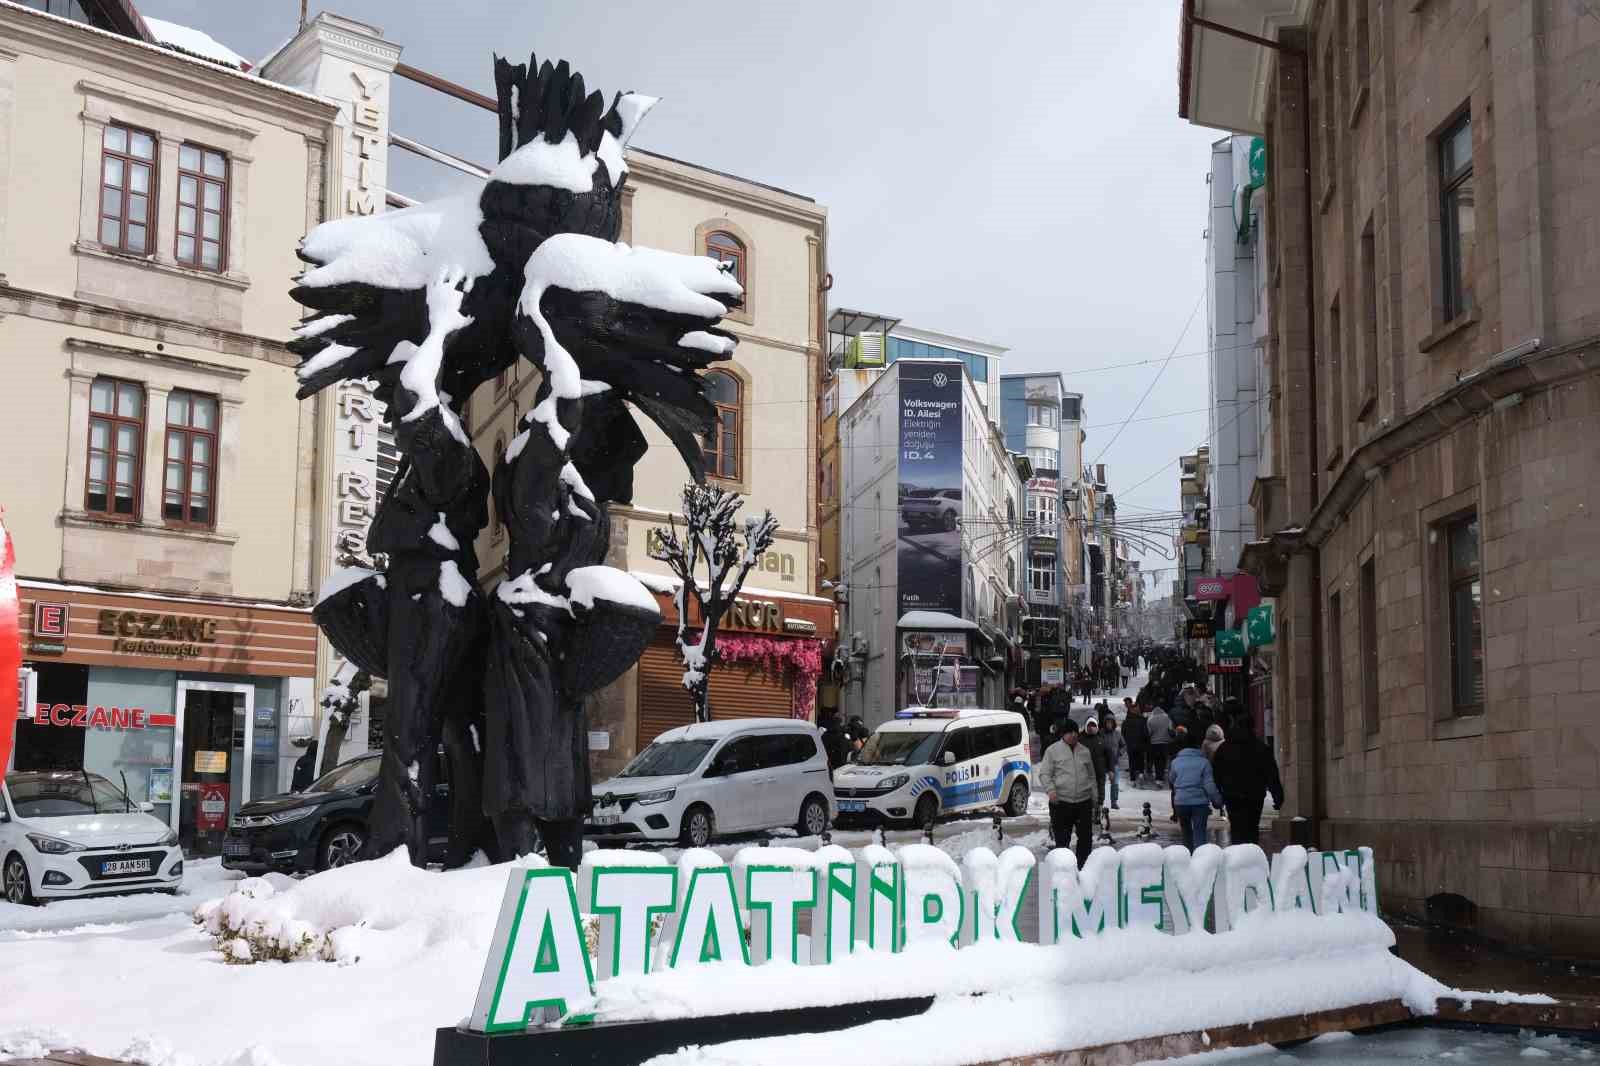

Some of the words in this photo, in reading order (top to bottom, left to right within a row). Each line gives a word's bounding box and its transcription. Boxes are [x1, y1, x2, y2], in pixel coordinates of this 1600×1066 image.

[904, 399, 957, 410] Volkswagen
[917, 409, 941, 418] Ailesi
[42, 607, 61, 632] E
[97, 608, 217, 643] ECZANE
[33, 703, 146, 729] ECZANE
[945, 768, 970, 785] POLİS
[107, 862, 117, 872] 28
